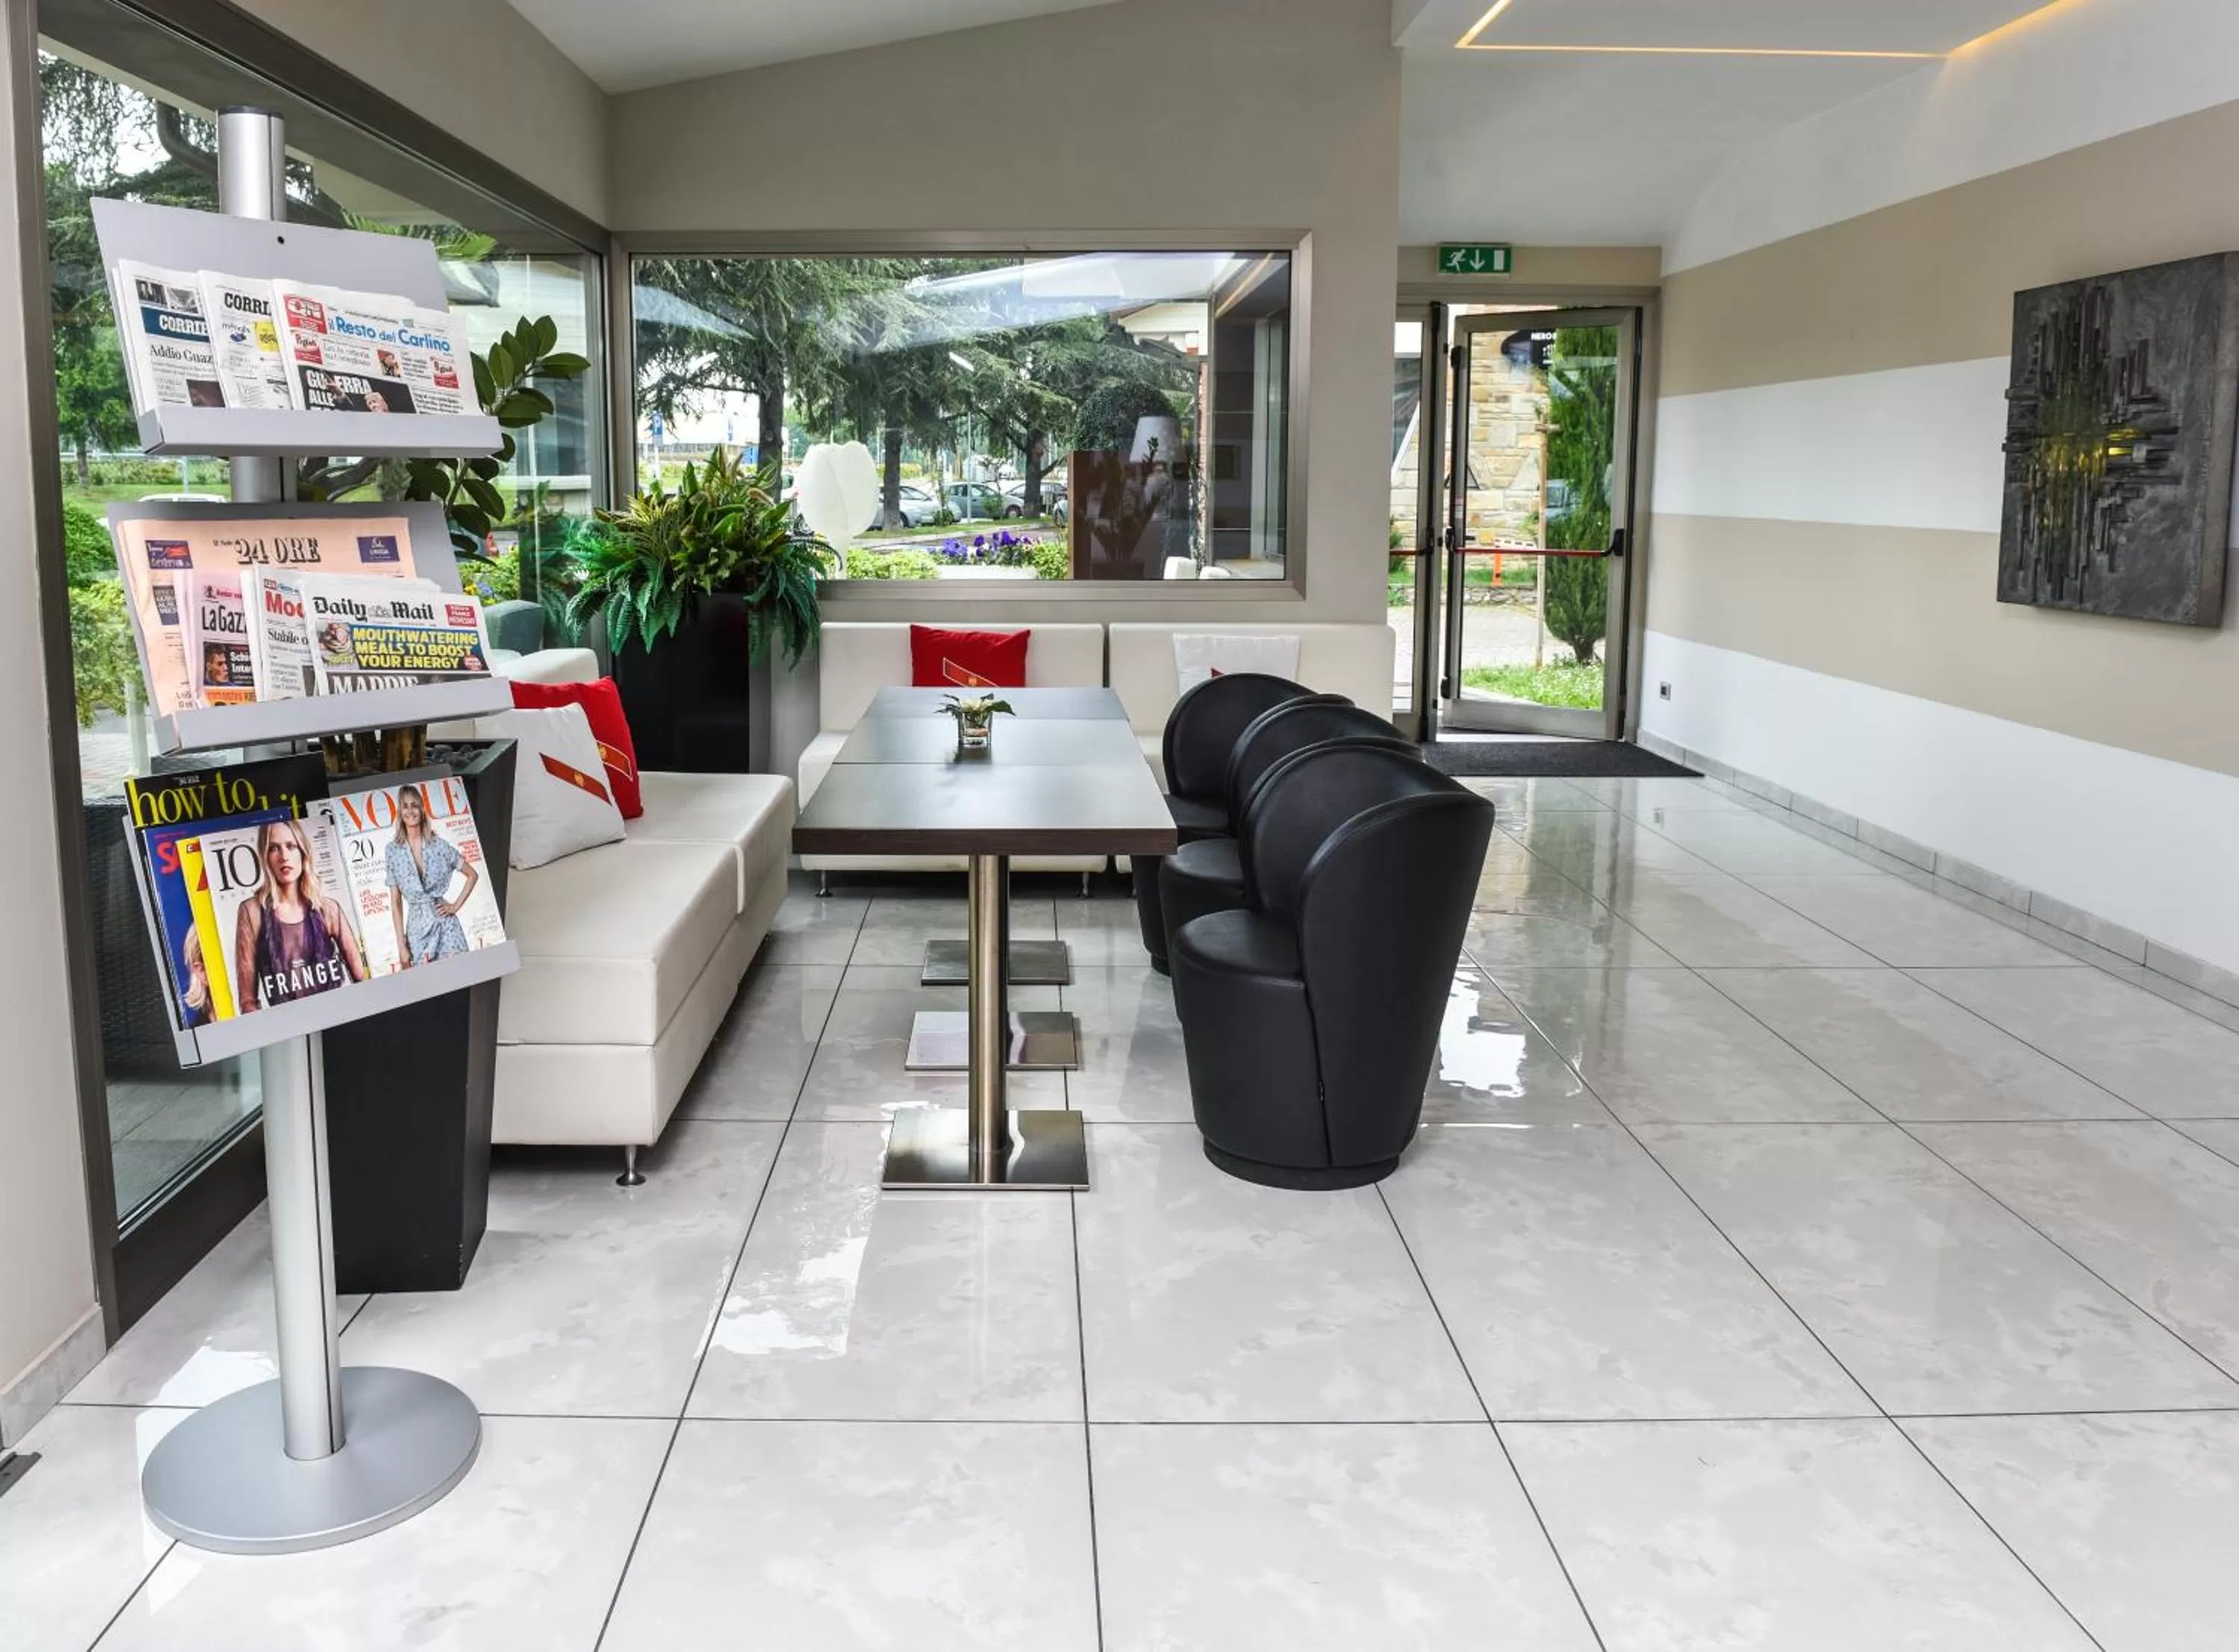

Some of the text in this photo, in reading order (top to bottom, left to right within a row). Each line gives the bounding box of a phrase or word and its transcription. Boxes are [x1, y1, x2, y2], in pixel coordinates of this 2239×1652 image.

[225, 292, 272, 316] CORRI
[336, 316, 376, 339] Resto
[379, 331, 396, 342] del
[398, 329, 451, 352] Carlino
[308, 389, 335, 407] ALLE
[234, 537, 269, 565] 24
[274, 537, 322, 563] ORE
[312, 597, 435, 622] Daily Mail
[353, 628, 478, 645] MOUTHWATERING
[355, 641, 472, 657] MEALS TO BOOST
[357, 654, 402, 668] YOUR
[404, 655, 460, 669] ENERGY
[125, 770, 256, 827] how to
[340, 776, 471, 833] VOUE
[349, 838, 375, 863] 20
[265, 959, 342, 998] FRANGE
